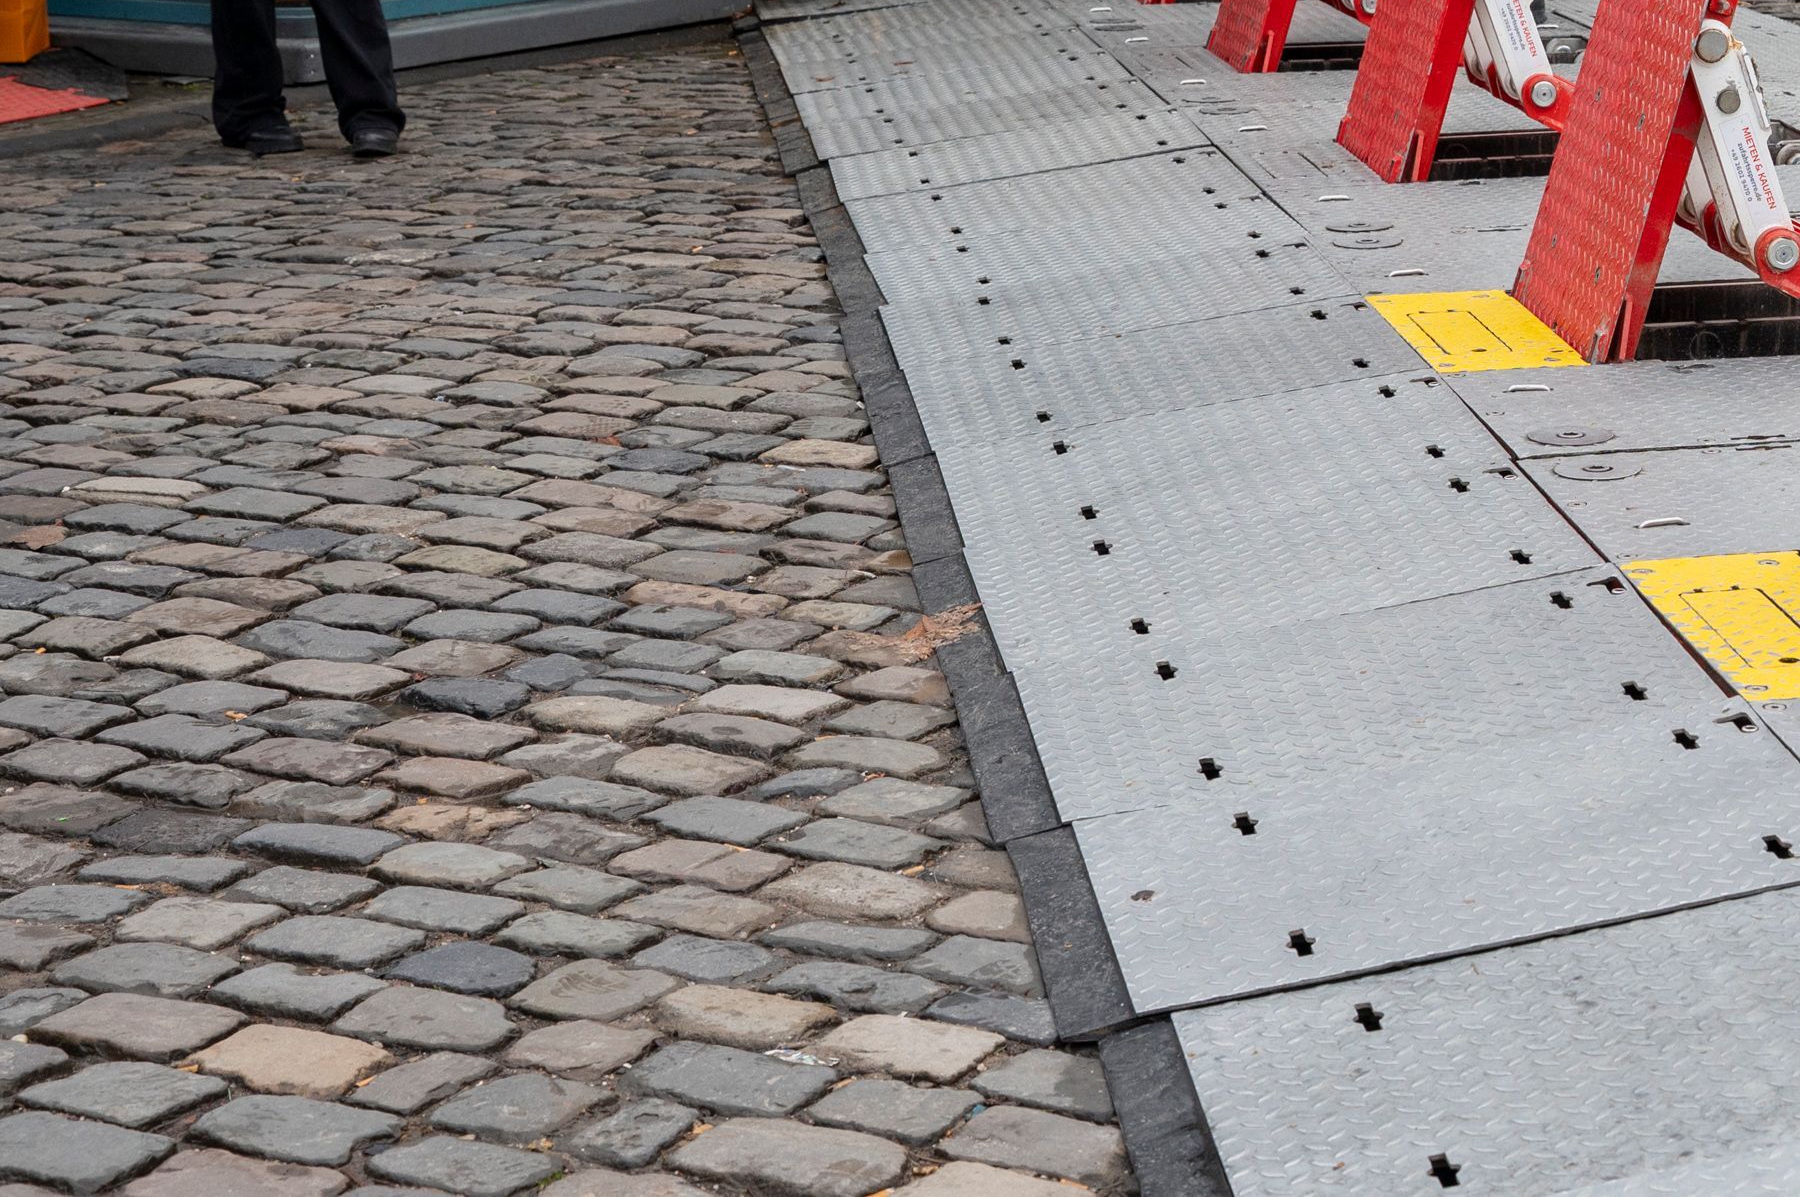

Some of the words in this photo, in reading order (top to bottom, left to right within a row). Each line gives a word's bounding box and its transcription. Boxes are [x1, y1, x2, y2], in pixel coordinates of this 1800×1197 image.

[1523, 27, 1537, 57] KAUFEN
[1738, 143, 1762, 201] zufahrtssperre.de
[1742, 127, 1760, 162] MIETEN
[1758, 173, 1776, 210] KAUFEN
